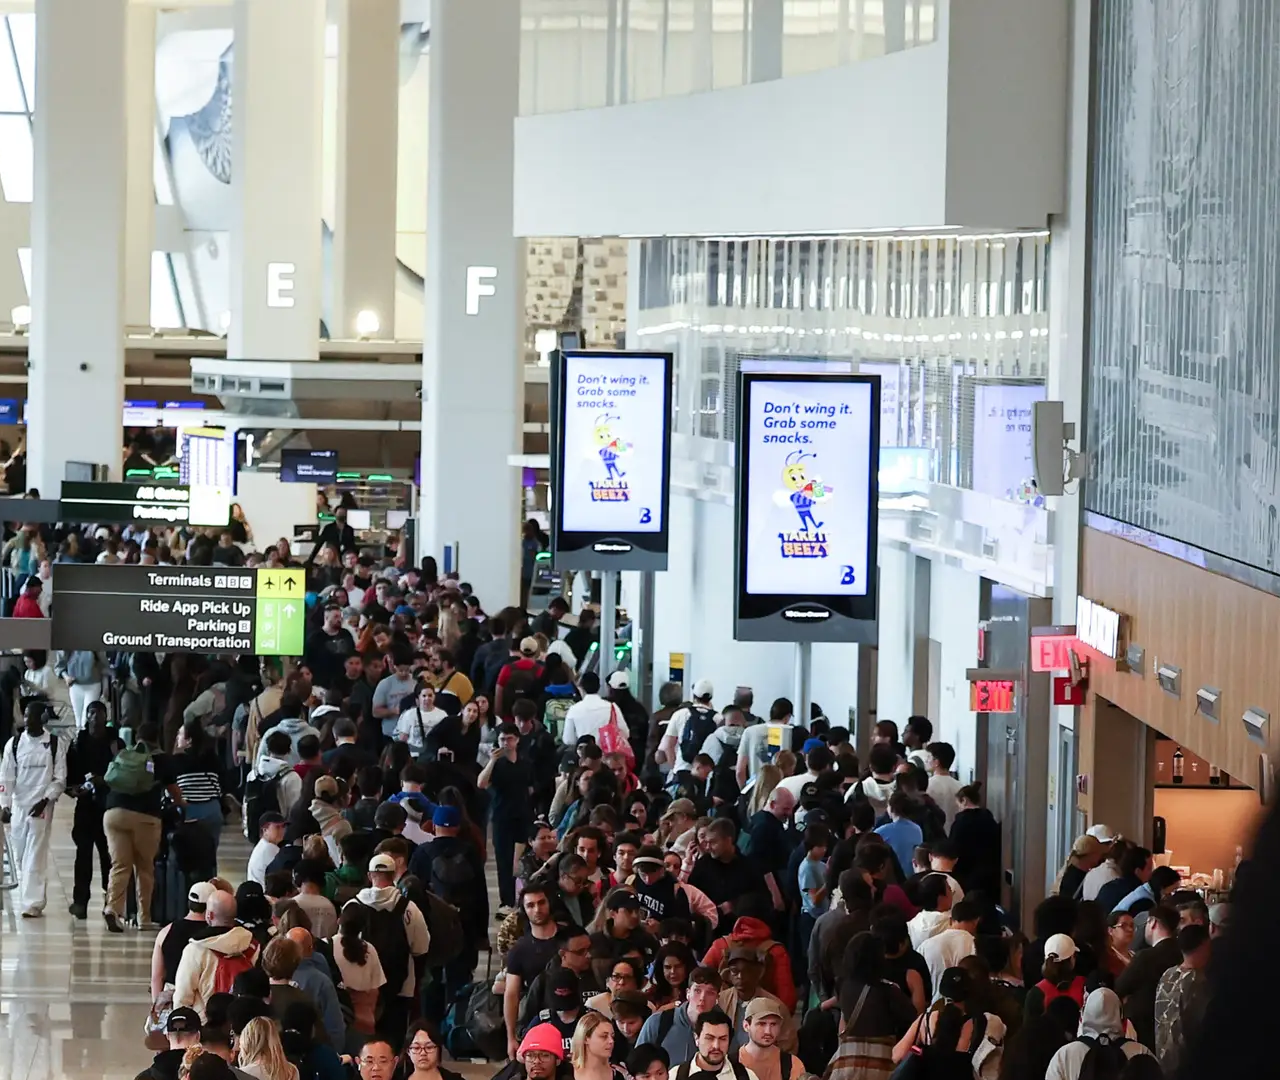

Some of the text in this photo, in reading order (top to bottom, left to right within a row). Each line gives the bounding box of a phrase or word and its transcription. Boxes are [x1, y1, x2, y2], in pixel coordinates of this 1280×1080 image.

[267, 263, 295, 307] E
[466, 266, 497, 314] F
[577, 374, 650, 387] Don't wing it.
[577, 386, 636, 397] Grab some
[577, 399, 617, 408] snacks.
[763, 402, 853, 417] Don't wing it.
[763, 417, 837, 429] Grab some
[763, 432, 813, 444] snacks.
[148, 573, 211, 587] Terminals
[140, 600, 251, 617] Ride App Pick Up
[187, 619, 236, 634] Parking
[102, 632, 251, 649] Ground Transportation
[976, 681, 1013, 711] EXIT
[644, 894, 664, 915] STATE
